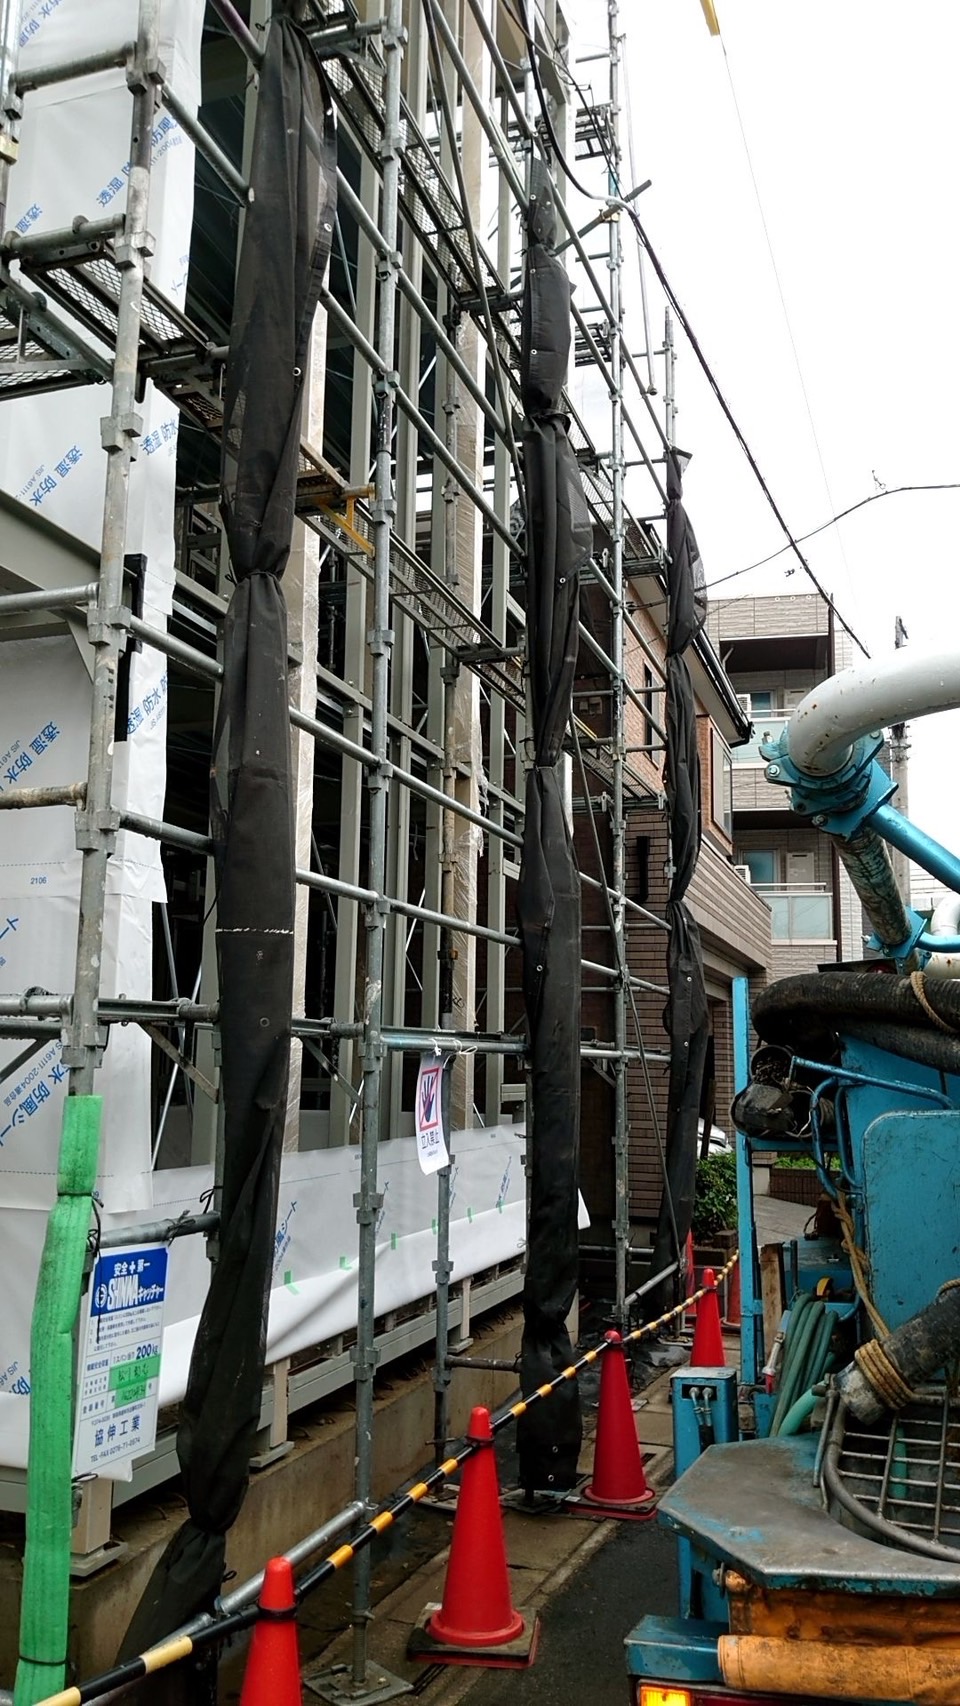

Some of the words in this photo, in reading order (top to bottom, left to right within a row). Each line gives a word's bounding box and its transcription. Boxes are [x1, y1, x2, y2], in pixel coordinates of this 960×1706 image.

[54, 444, 83, 479] 透湿
[29, 474, 57, 507] 防水
[29, 721, 60, 756] 透湿
[3, 751, 33, 784] 防水
[30, 876, 47, 885] 2106
[0, 1080, 51, 1147] 防風シー
